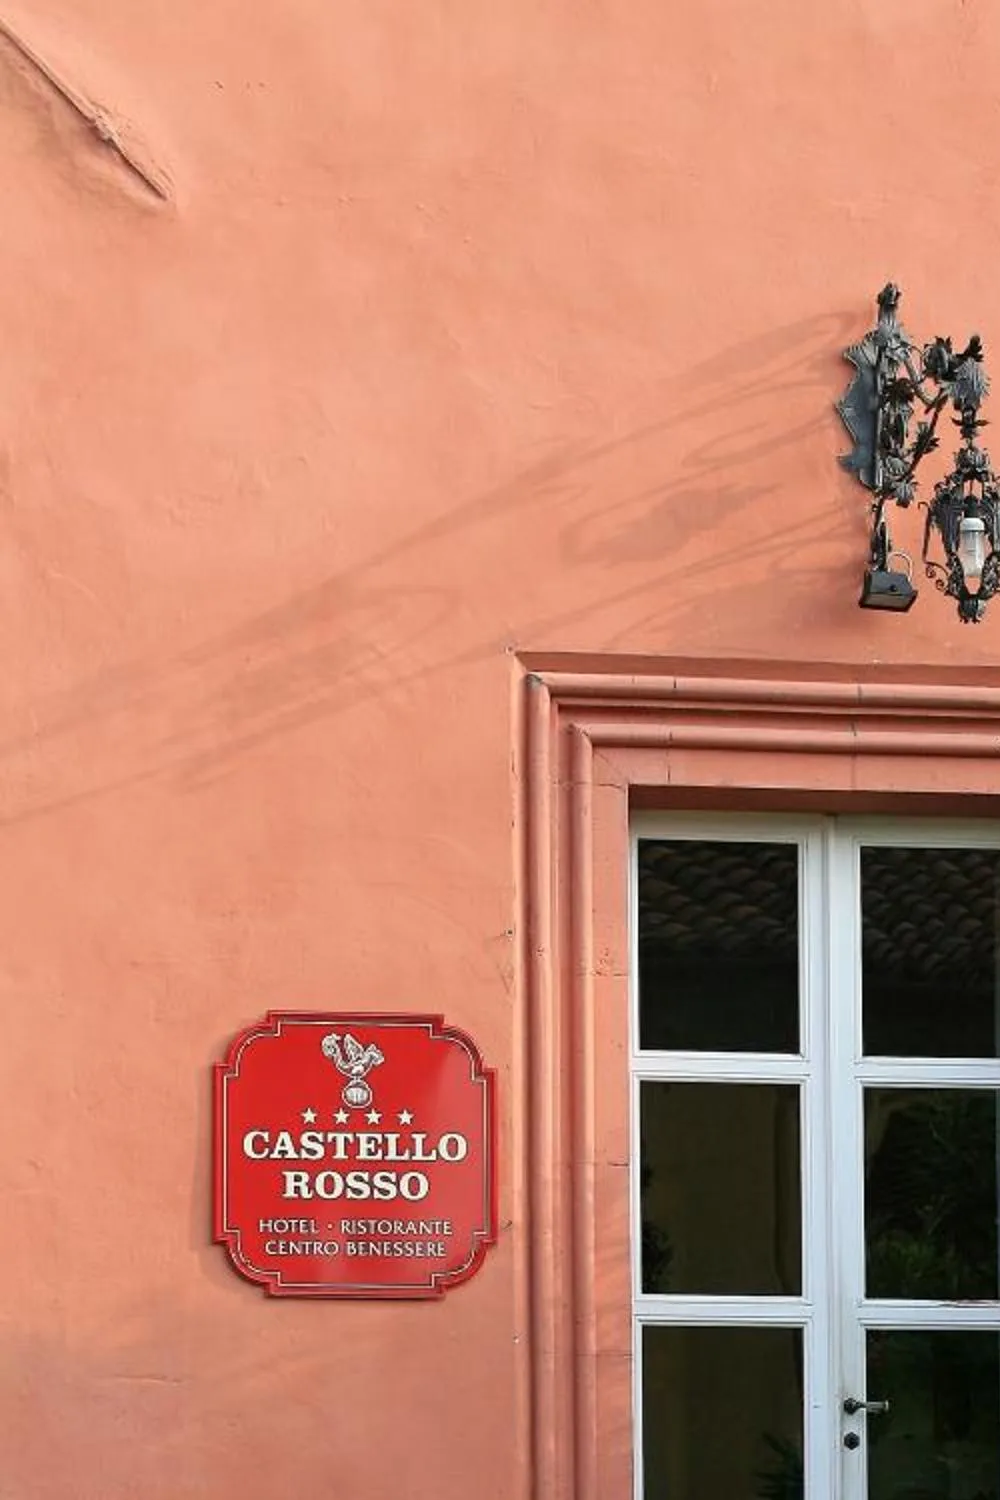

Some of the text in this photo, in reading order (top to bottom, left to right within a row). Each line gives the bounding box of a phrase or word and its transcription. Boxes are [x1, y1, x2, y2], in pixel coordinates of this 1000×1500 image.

[243, 1131, 468, 1161] CASTELLO
[282, 1171, 429, 1200] ROSSO
[259, 1219, 452, 1235] HOTEL RISTORANTE
[265, 1240, 447, 1257] CENTRO BENESSERE
